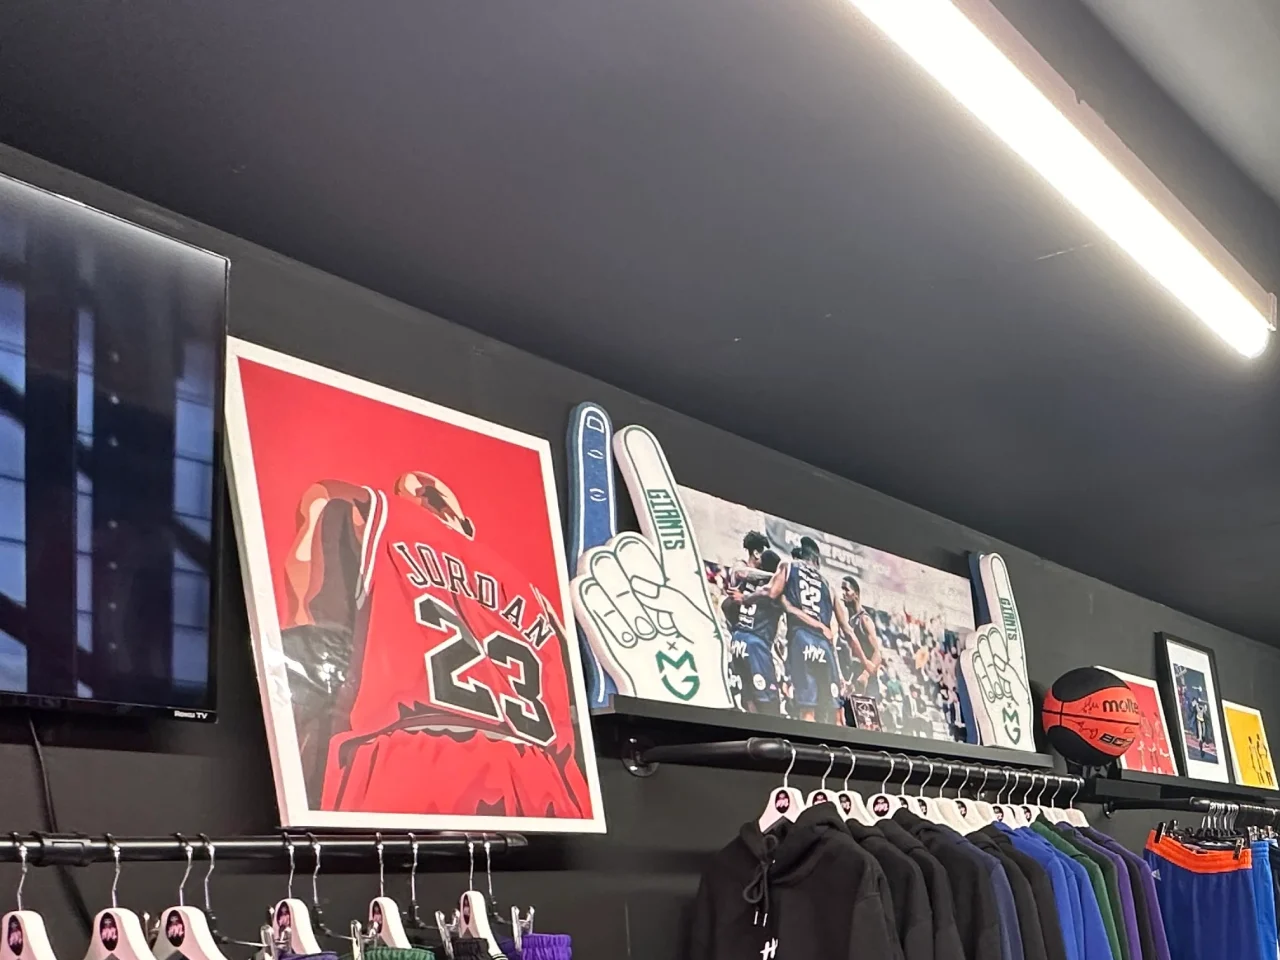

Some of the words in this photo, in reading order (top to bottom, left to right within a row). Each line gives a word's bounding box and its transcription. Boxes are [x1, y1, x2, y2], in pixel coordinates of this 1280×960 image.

[646, 488, 685, 550] GIANTS
[393, 542, 554, 650] JORDAN
[999, 597, 1017, 641] GIANTS
[413, 593, 557, 747] 23
[196, 711, 208, 719] TV
[1103, 699, 1139, 714] molte
